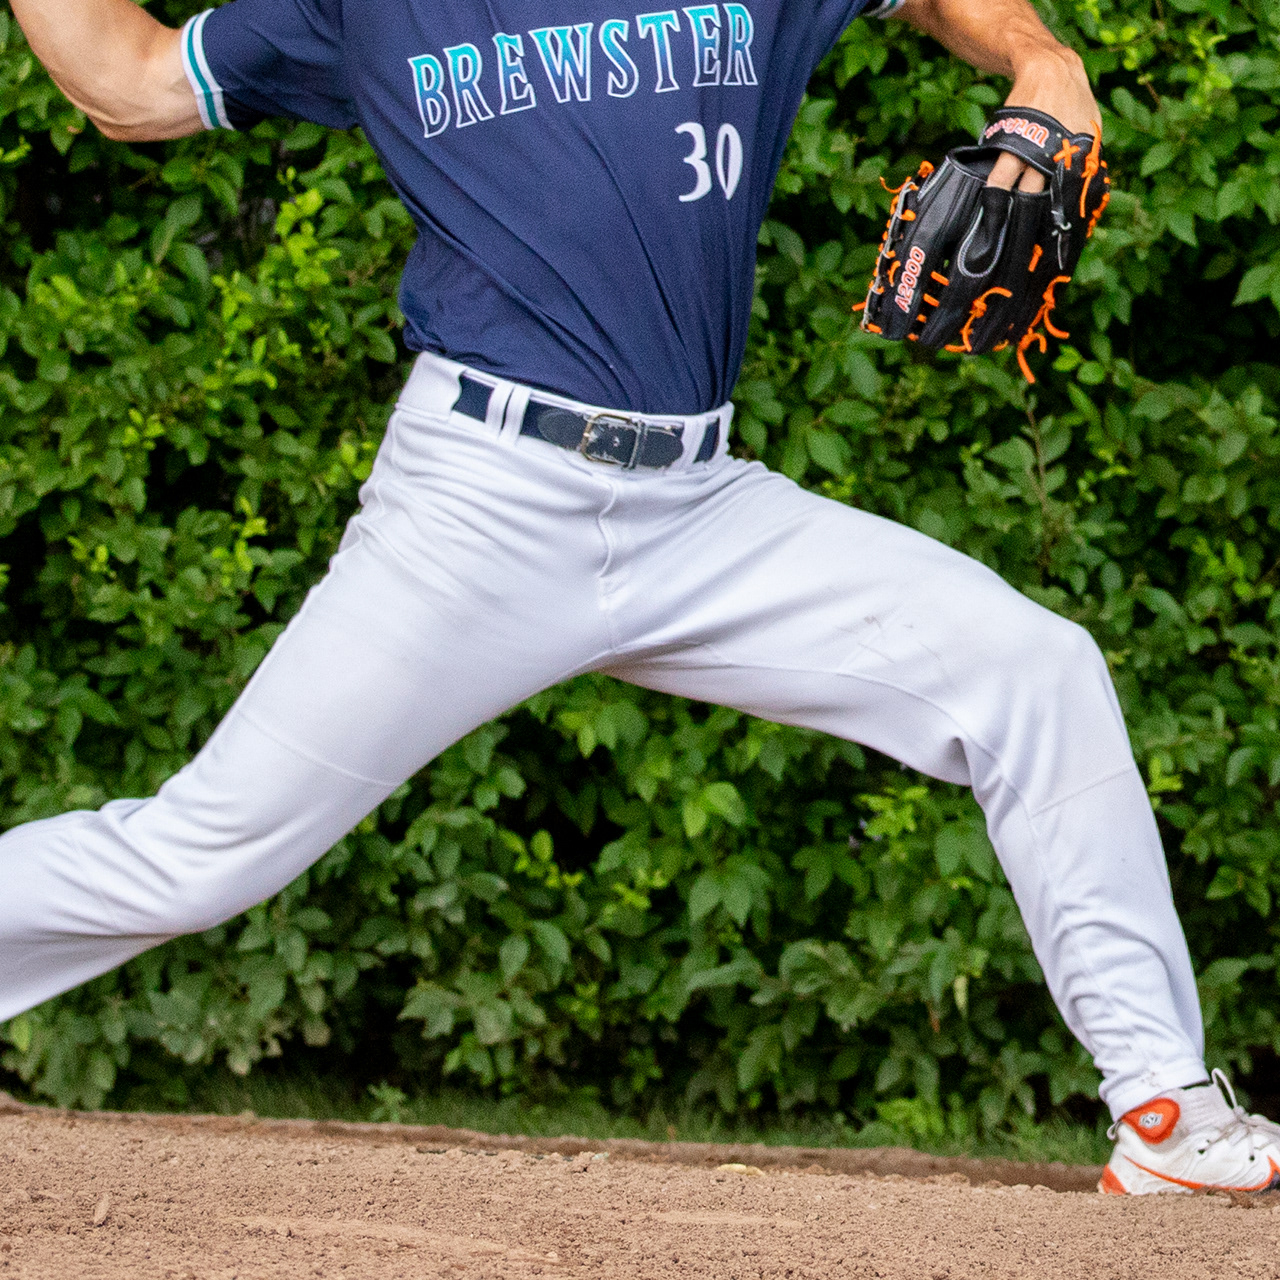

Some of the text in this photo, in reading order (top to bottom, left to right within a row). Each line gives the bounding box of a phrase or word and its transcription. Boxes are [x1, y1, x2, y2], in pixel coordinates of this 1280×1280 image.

[407, 2, 759, 139] BREWSTER
[674, 121, 744, 203] 30
[894, 245, 926, 314] A2000
